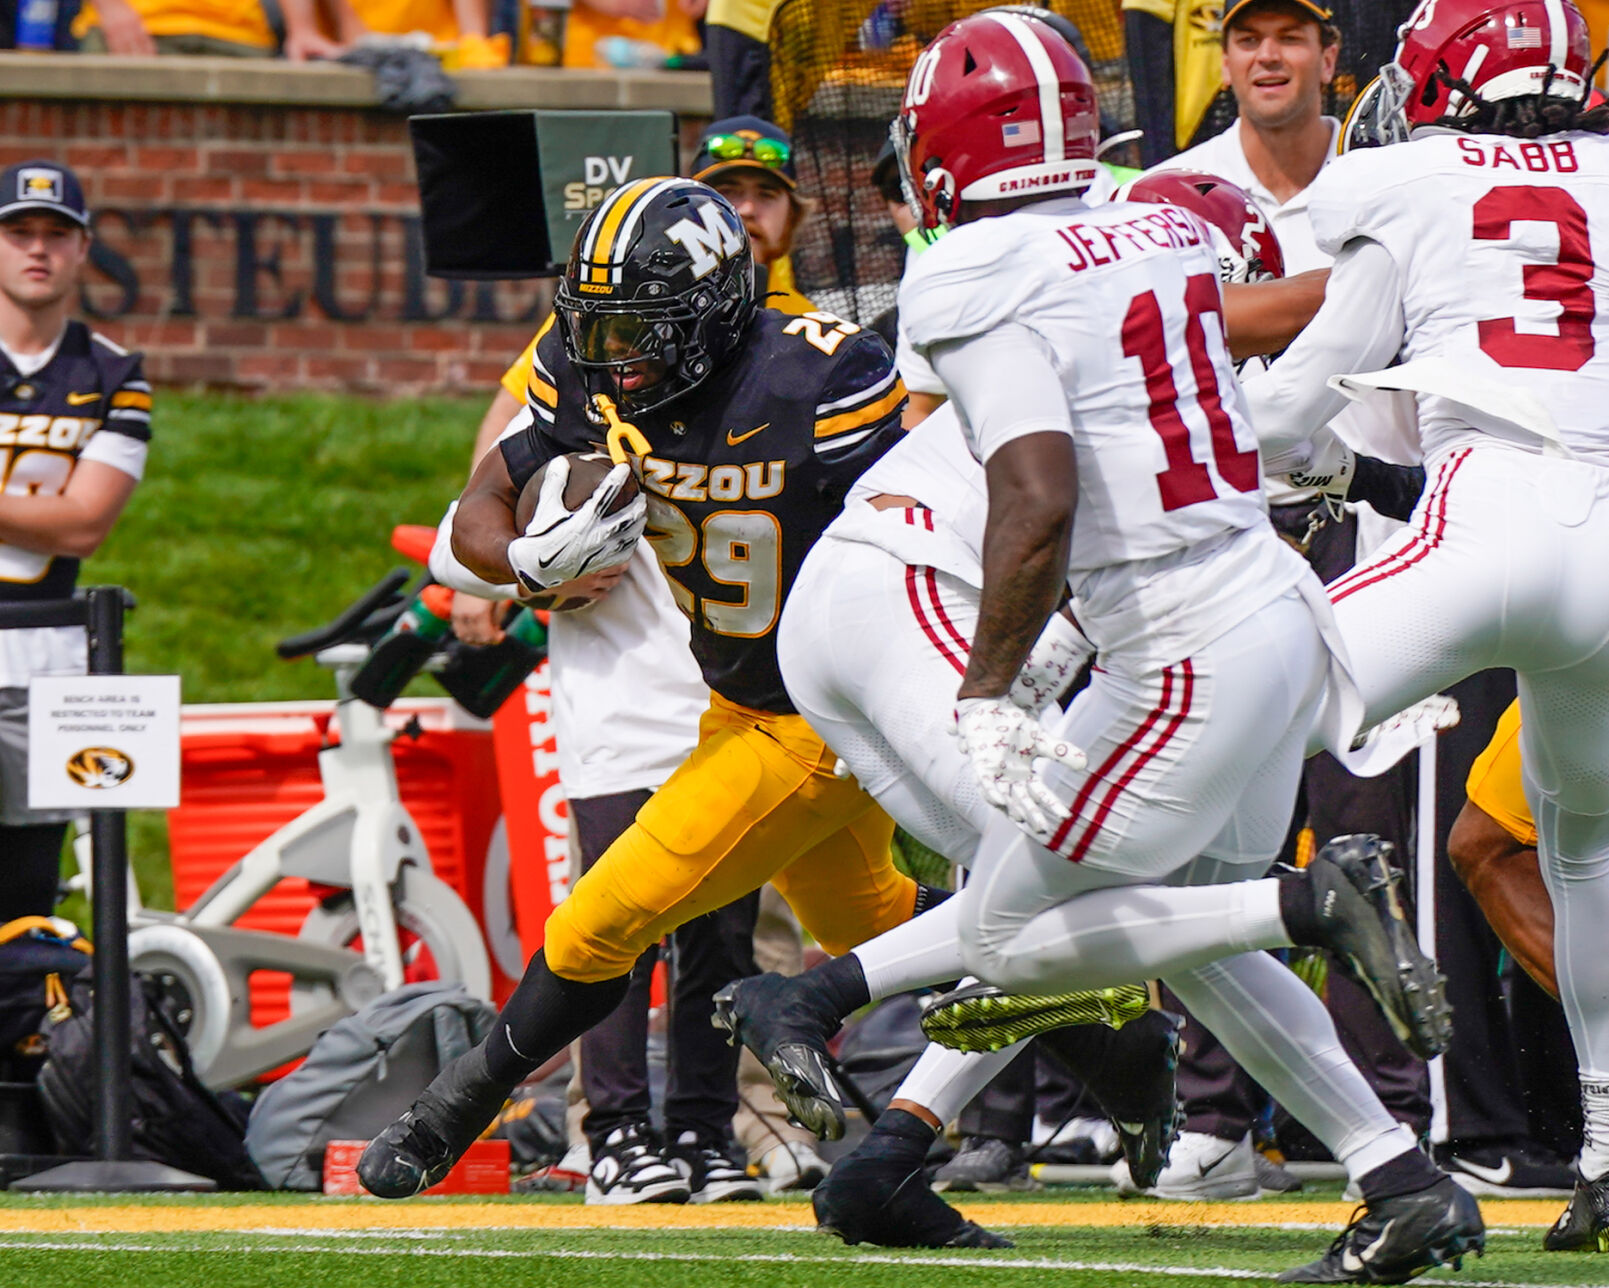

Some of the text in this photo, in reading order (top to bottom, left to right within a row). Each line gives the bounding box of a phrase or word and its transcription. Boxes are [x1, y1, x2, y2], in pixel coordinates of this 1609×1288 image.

[905, 42, 942, 108] 10
[584, 155, 633, 185] DV
[1457, 137, 1579, 173] SABB
[1000, 172, 1070, 192] CRIMSON
[664, 202, 742, 281] M
[1473, 185, 1596, 371] 3
[781, 310, 862, 356] 29
[97, 695, 126, 704] AREA
